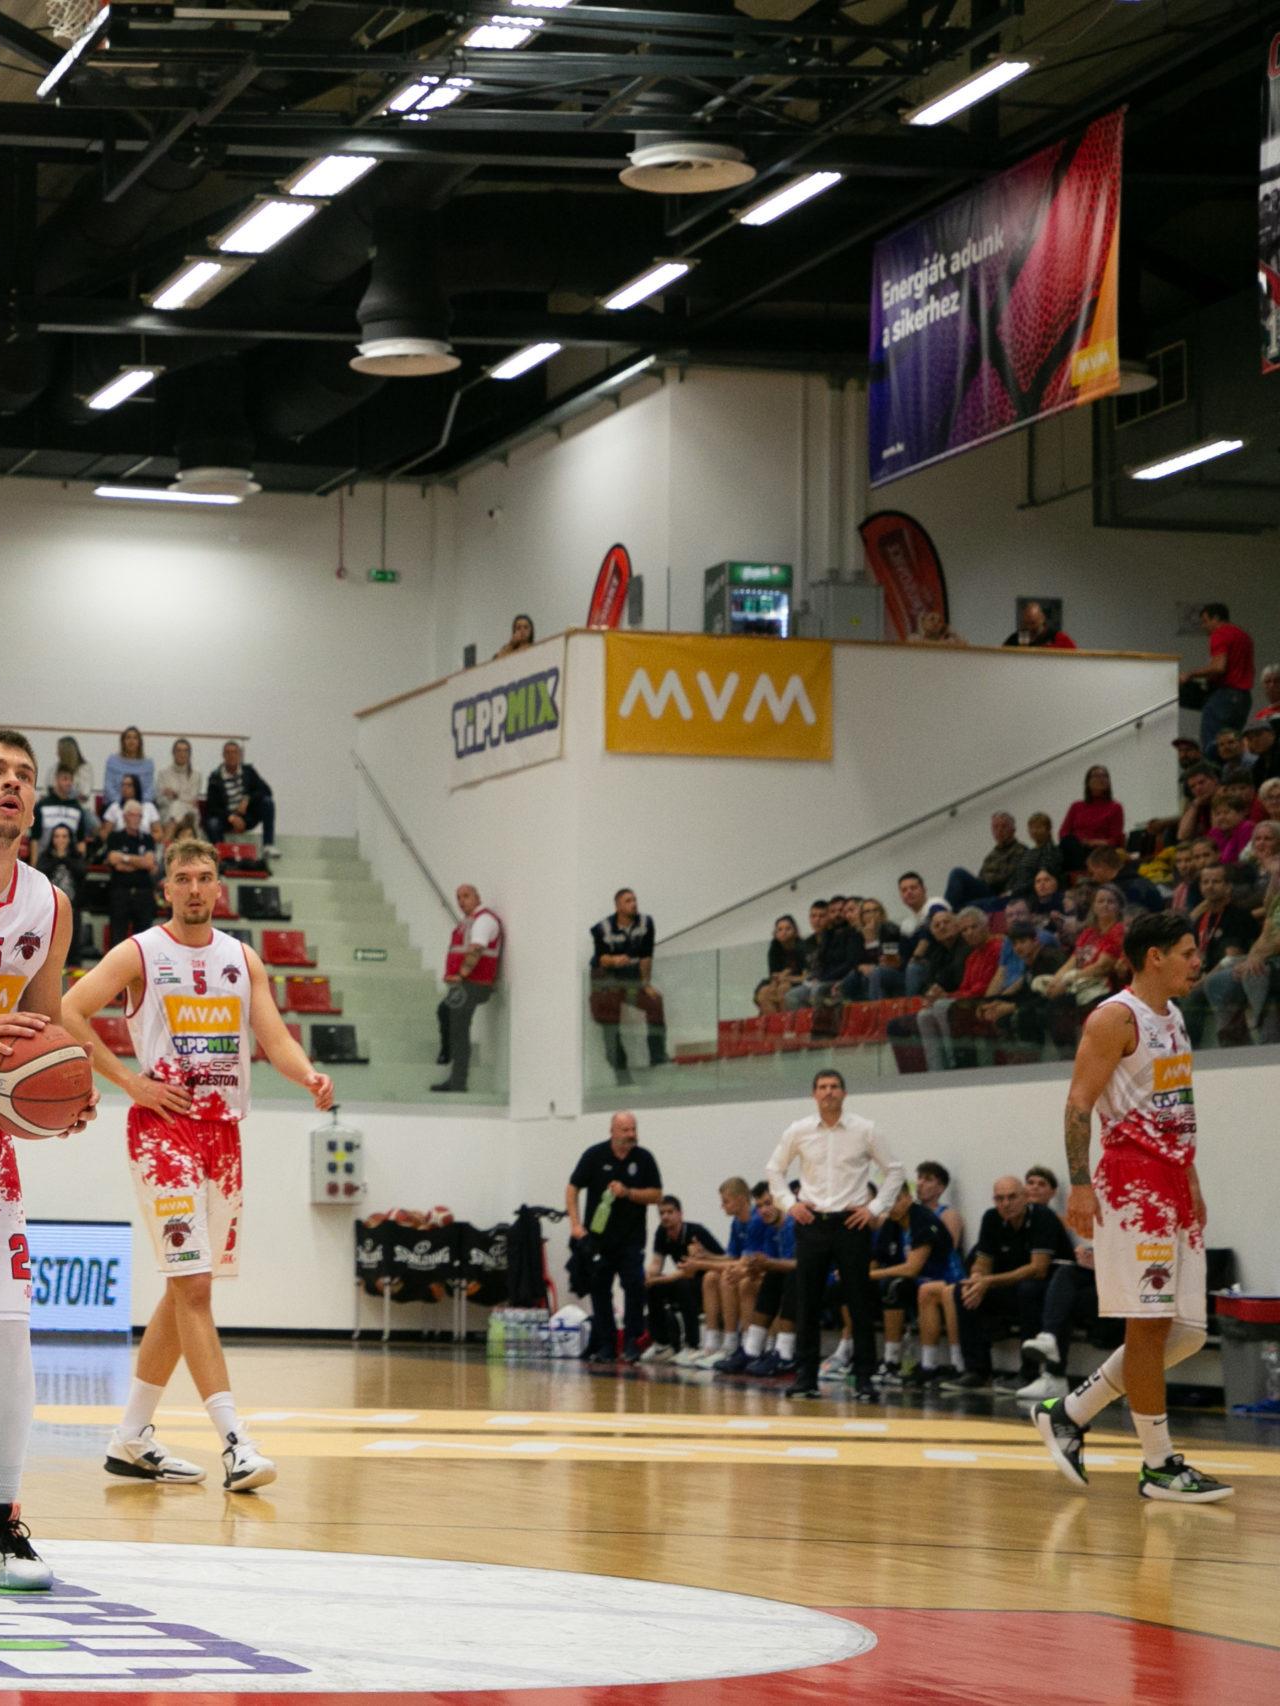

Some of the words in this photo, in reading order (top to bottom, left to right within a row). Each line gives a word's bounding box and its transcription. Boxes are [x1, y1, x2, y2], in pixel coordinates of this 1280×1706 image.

[882, 250, 947, 310] Energiát
[951, 224, 1004, 274] adunk
[882, 328, 890, 349] a
[892, 290, 960, 343] sikerhez
[620, 667, 816, 724] MVM
[193, 970, 207, 995] 5
[177, 1005, 233, 1024] MVM
[30, 1256, 118, 1305] ESTONE
